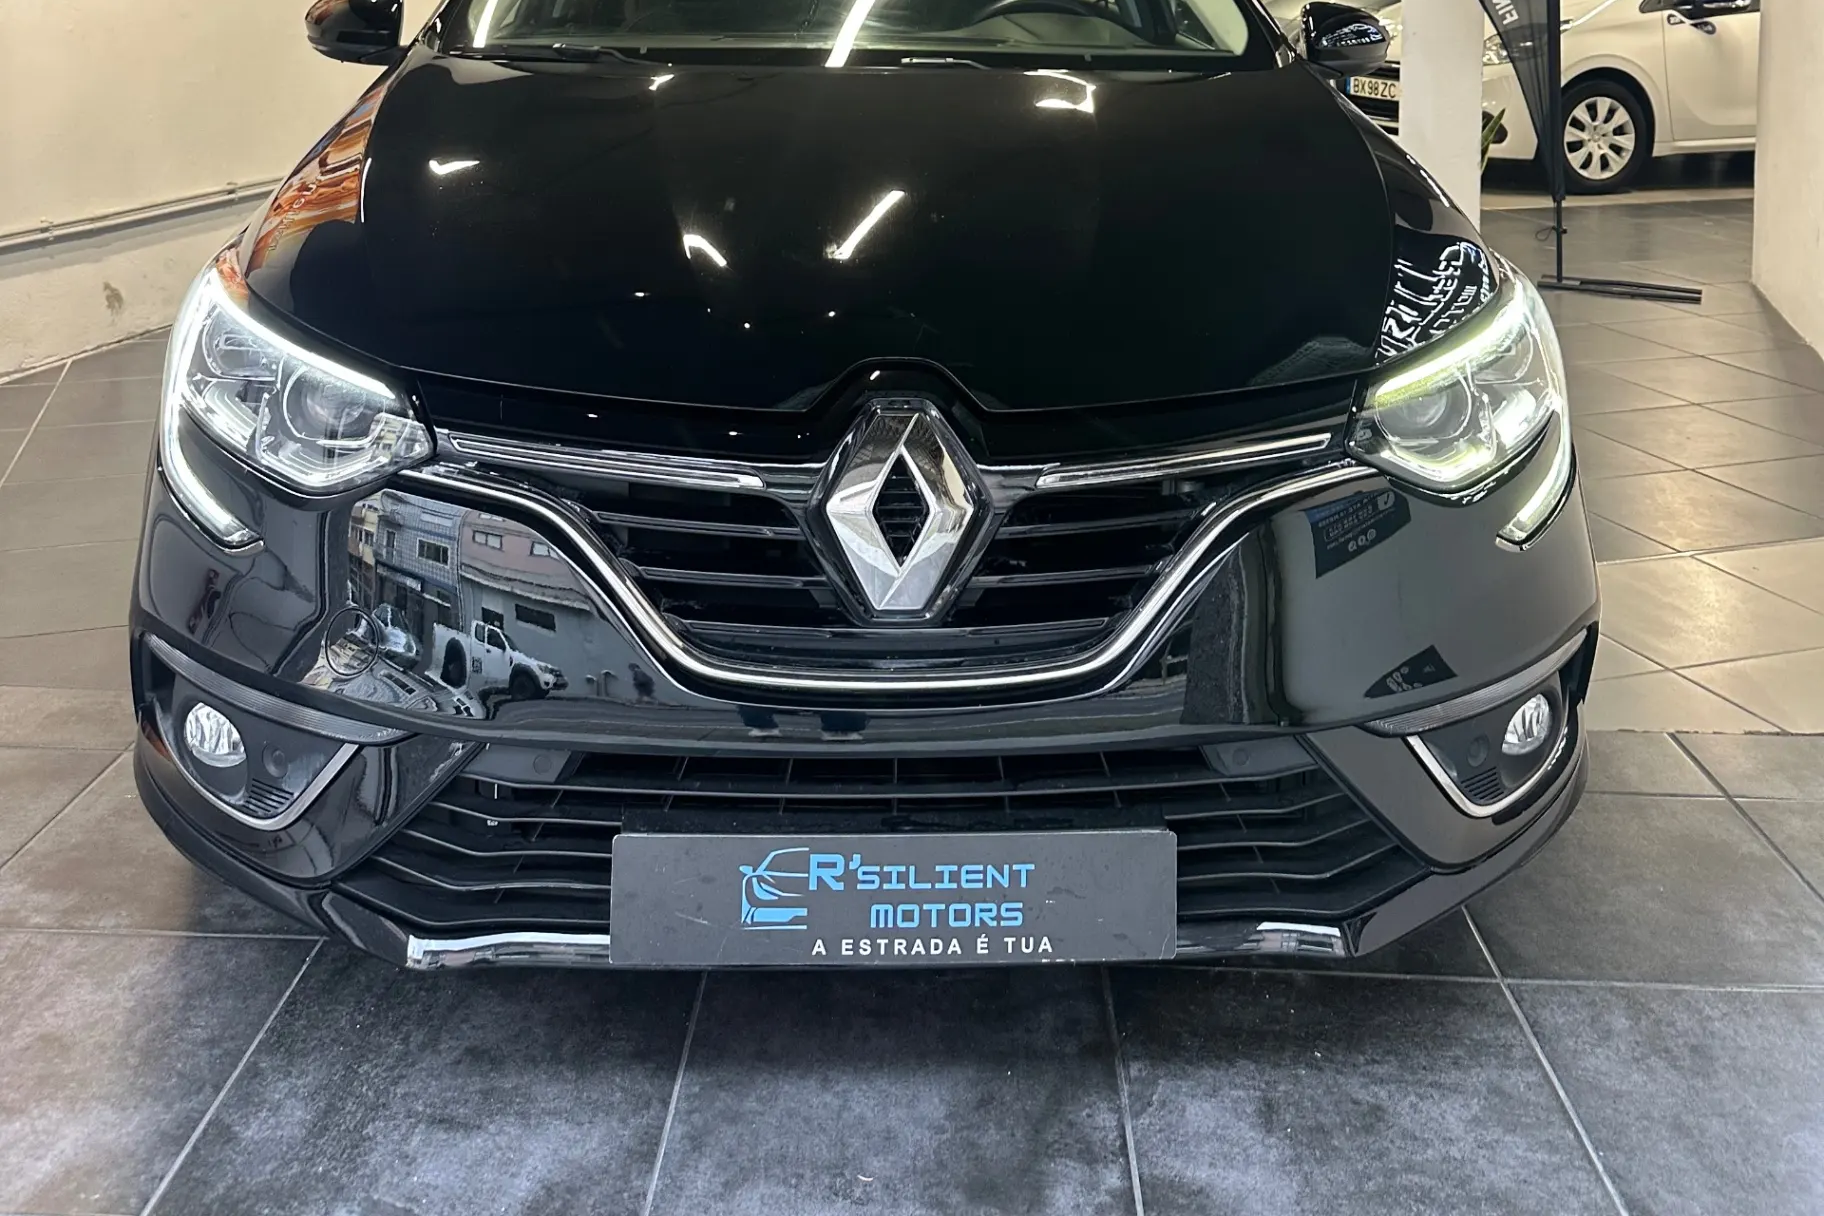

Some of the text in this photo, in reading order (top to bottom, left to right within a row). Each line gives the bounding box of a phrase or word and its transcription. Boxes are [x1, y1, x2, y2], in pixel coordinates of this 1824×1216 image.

[808, 853, 1036, 891] R'SILIENT
[870, 902, 1024, 929] MOTORS
[811, 933, 1054, 956] A ESTRADA É TUA
